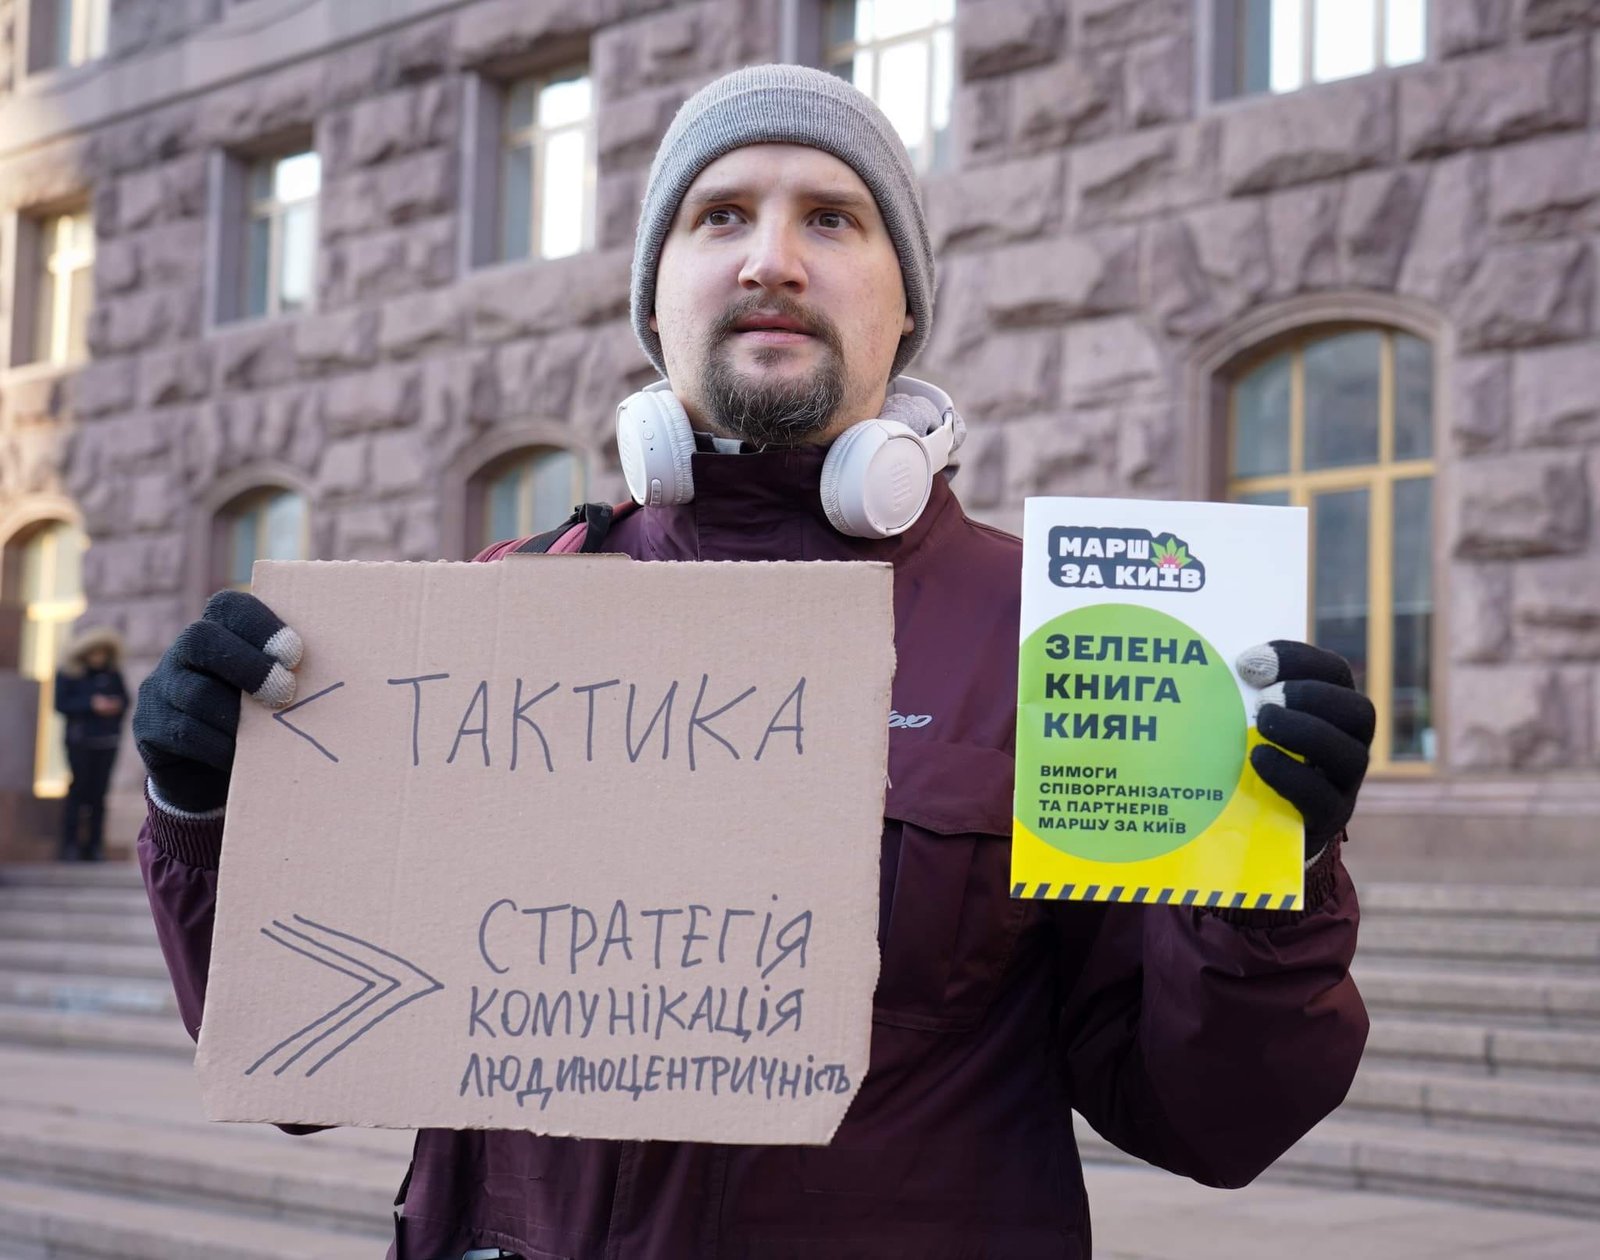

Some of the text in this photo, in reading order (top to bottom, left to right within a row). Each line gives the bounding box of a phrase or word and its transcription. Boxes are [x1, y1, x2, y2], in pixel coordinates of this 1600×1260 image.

[1059, 536, 1150, 560] МАРШ
[1060, 563, 1201, 589] ЗА КИЇВ
[1045, 633, 1208, 665] ЗЕЛЕНА
[1045, 673, 1181, 703] КНИГА
[387, 673, 807, 773] ТАКТИКА
[1043, 712, 1157, 742] КИЯН
[1040, 765, 1117, 779] ВИМОГИ
[1039, 782, 1223, 801] СПІВОРГАНІЗАТОРІВ
[1039, 799, 1169, 816] ТА ПАРТНЕРІВ
[1038, 816, 1187, 834] МАРШУ ЗА КИЇВ
